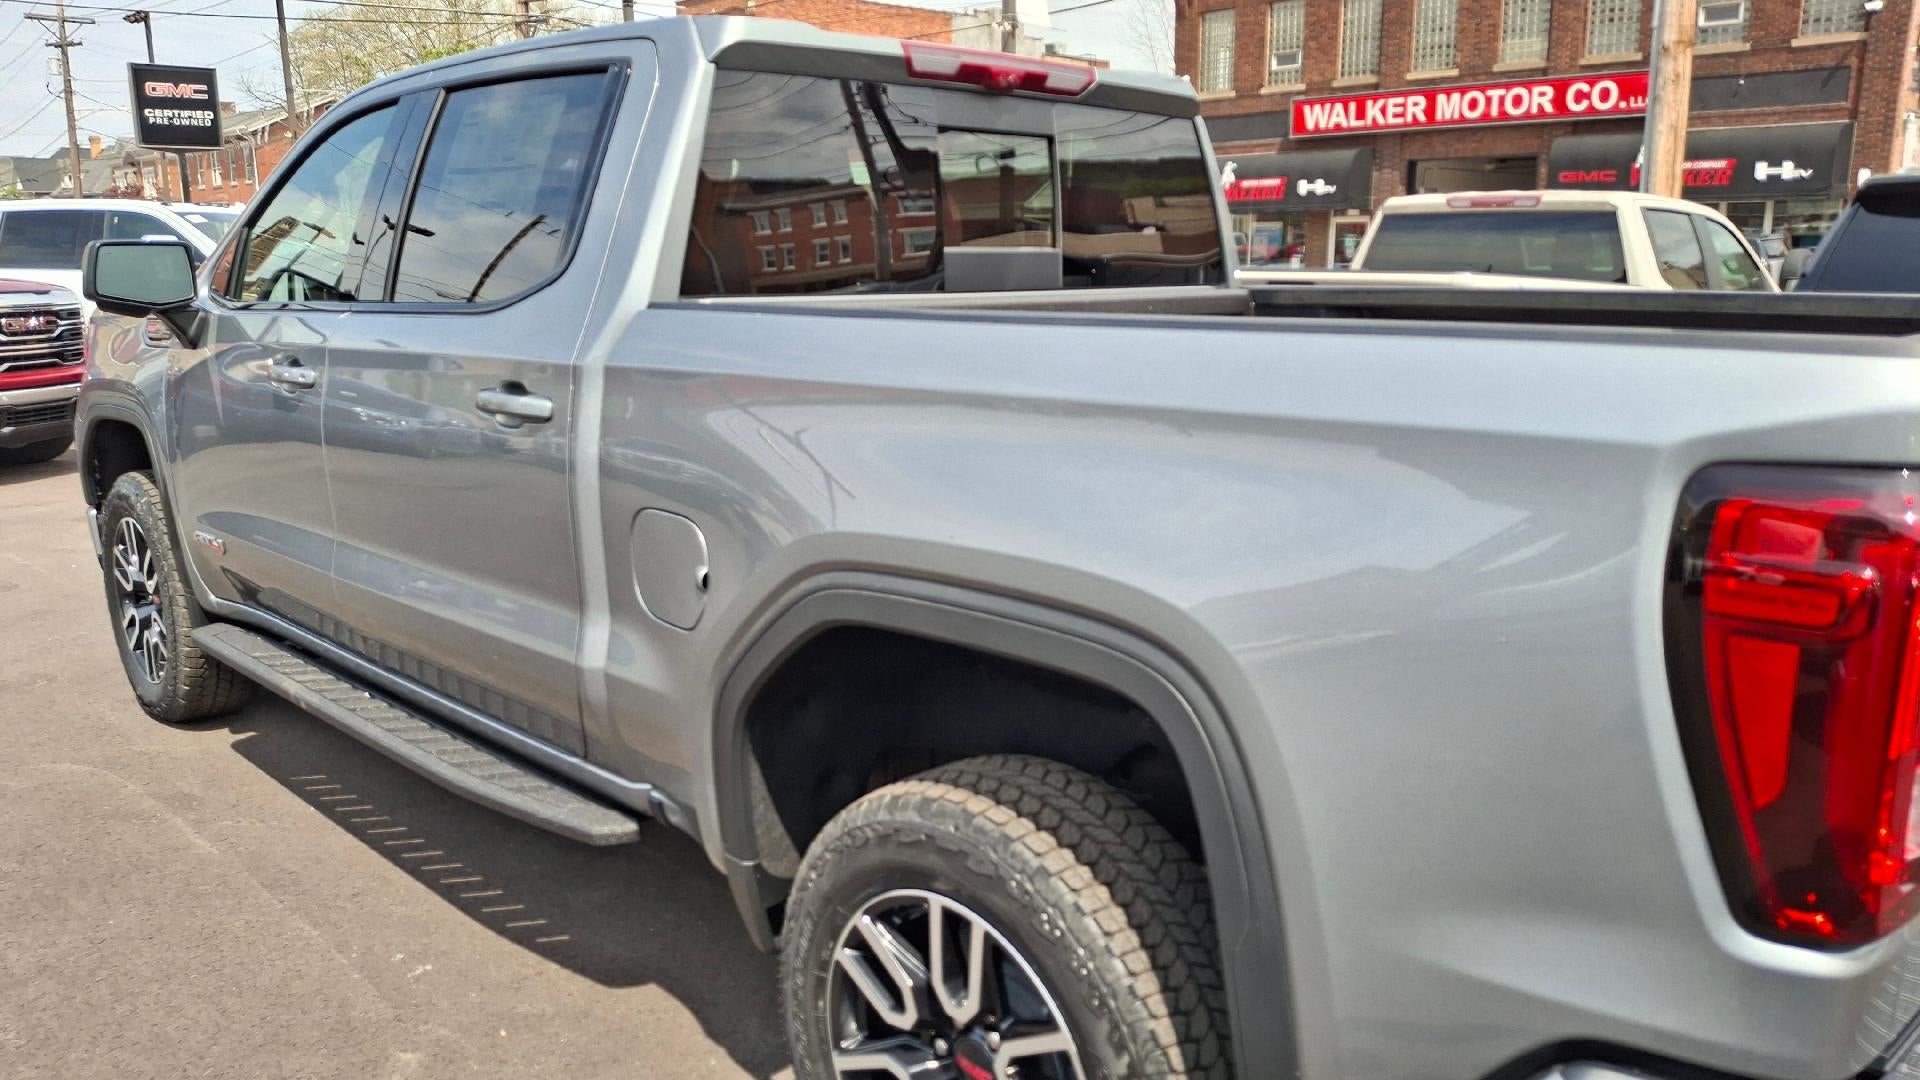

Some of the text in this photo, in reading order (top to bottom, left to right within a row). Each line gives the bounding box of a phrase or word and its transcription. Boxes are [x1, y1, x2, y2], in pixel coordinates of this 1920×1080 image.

[144, 81, 209, 100] GMC
[144, 108, 215, 120] CERTIFIED
[1303, 95, 1427, 131] WALKER
[1435, 85, 1554, 122] MOTOR
[149, 116, 212, 127] PRE-OWNED
[1558, 169, 1617, 184] GMC
